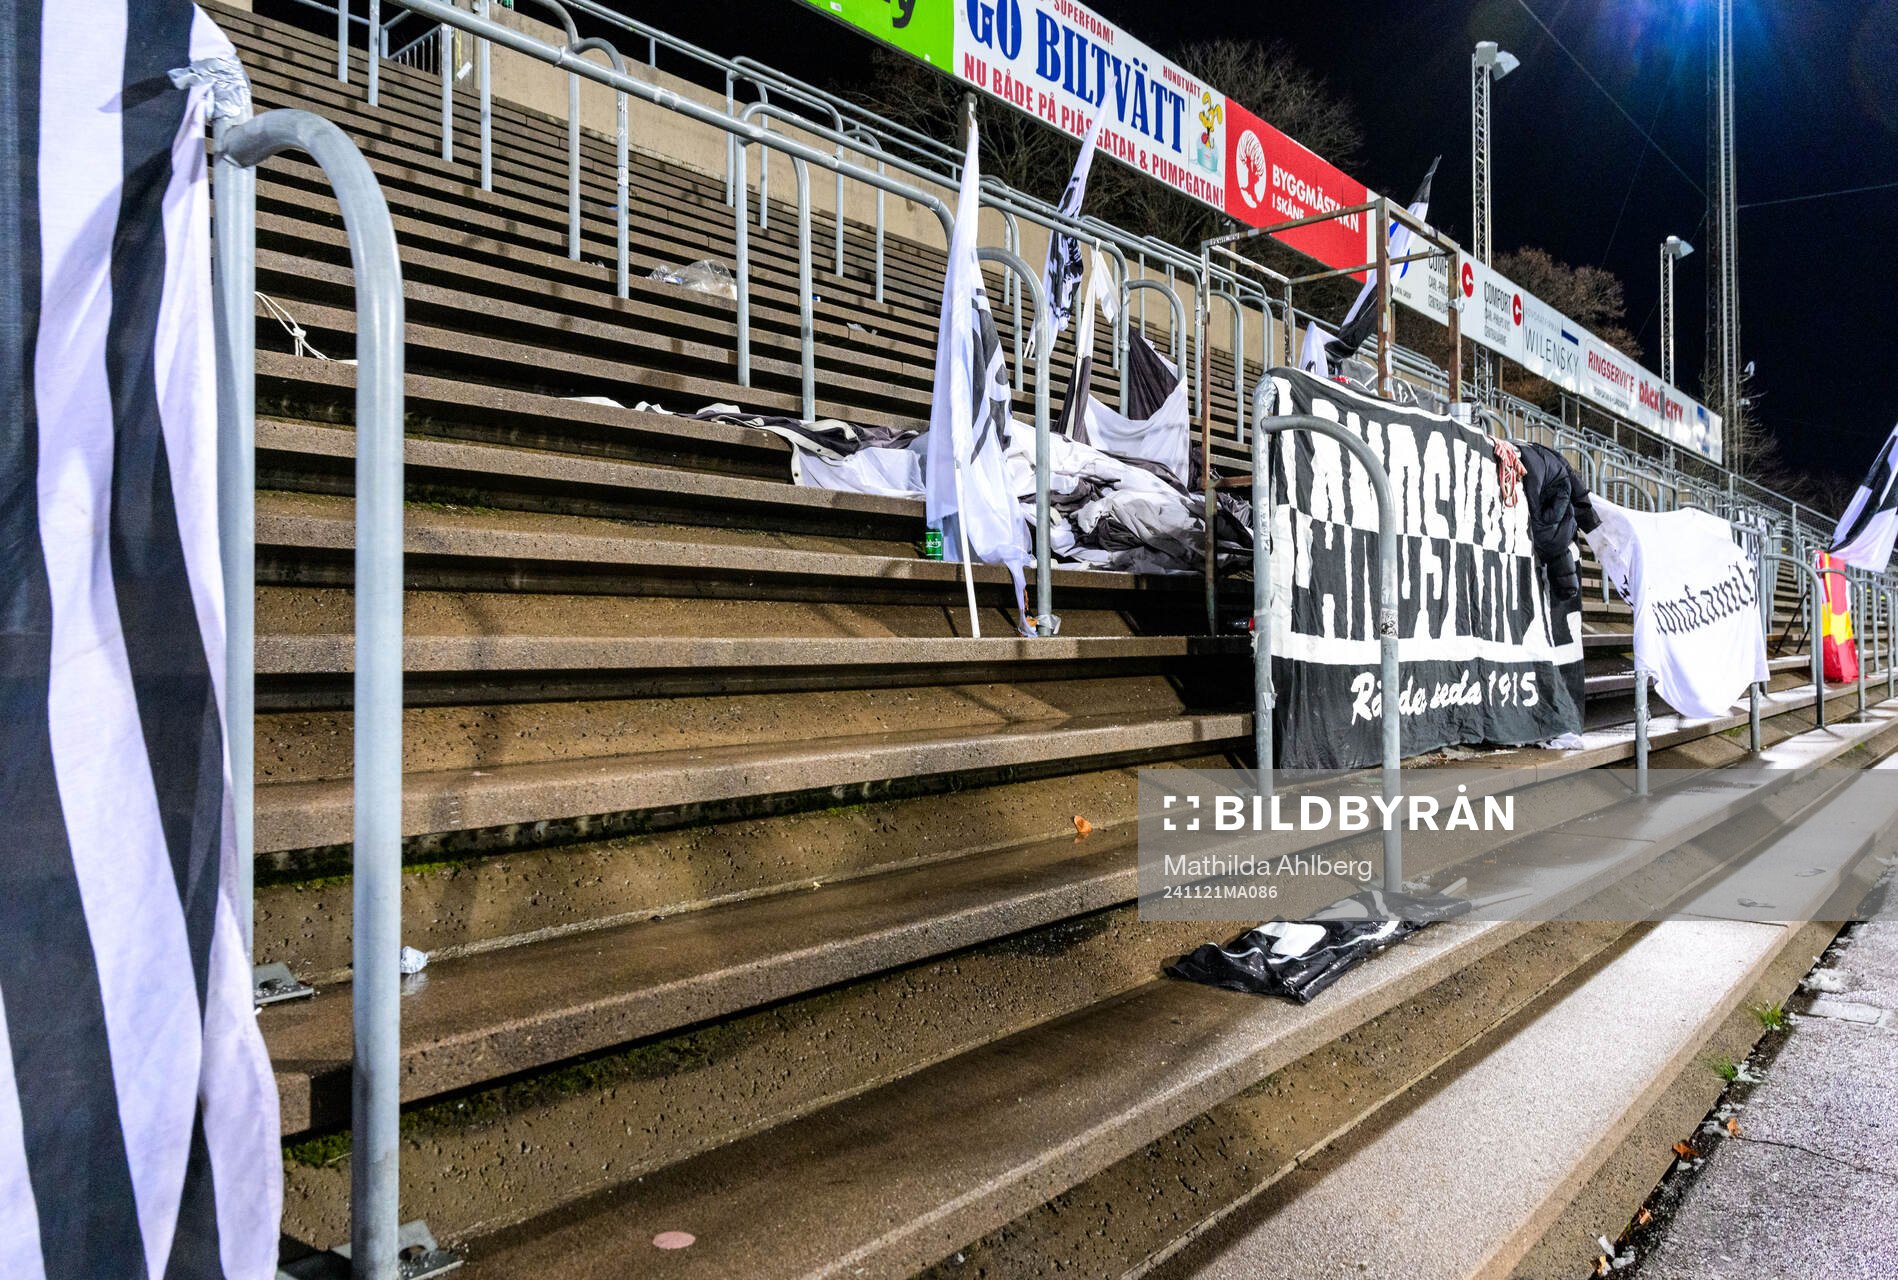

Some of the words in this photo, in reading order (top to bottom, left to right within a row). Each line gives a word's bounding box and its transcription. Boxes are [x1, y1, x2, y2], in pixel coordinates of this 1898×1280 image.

[966, 0, 1023, 60] GO
[1036, 8, 1185, 154] BILTVÄTT
[964, 52, 987, 87] NU
[993, 69, 1033, 112] BÅDE
[1039, 92, 1056, 124] PÅ
[1139, 150, 1149, 171] &
[1152, 154, 1224, 208] PUMPGATAN!
[1277, 196, 1304, 220] SKÅNE
[1484, 281, 1511, 316] COMFORT
[1525, 326, 1579, 376] WILENSKY
[1588, 350, 1635, 392] RINGSERVICE
[1665, 398, 1684, 421] CITY
[1489, 670, 1539, 708] 1915
